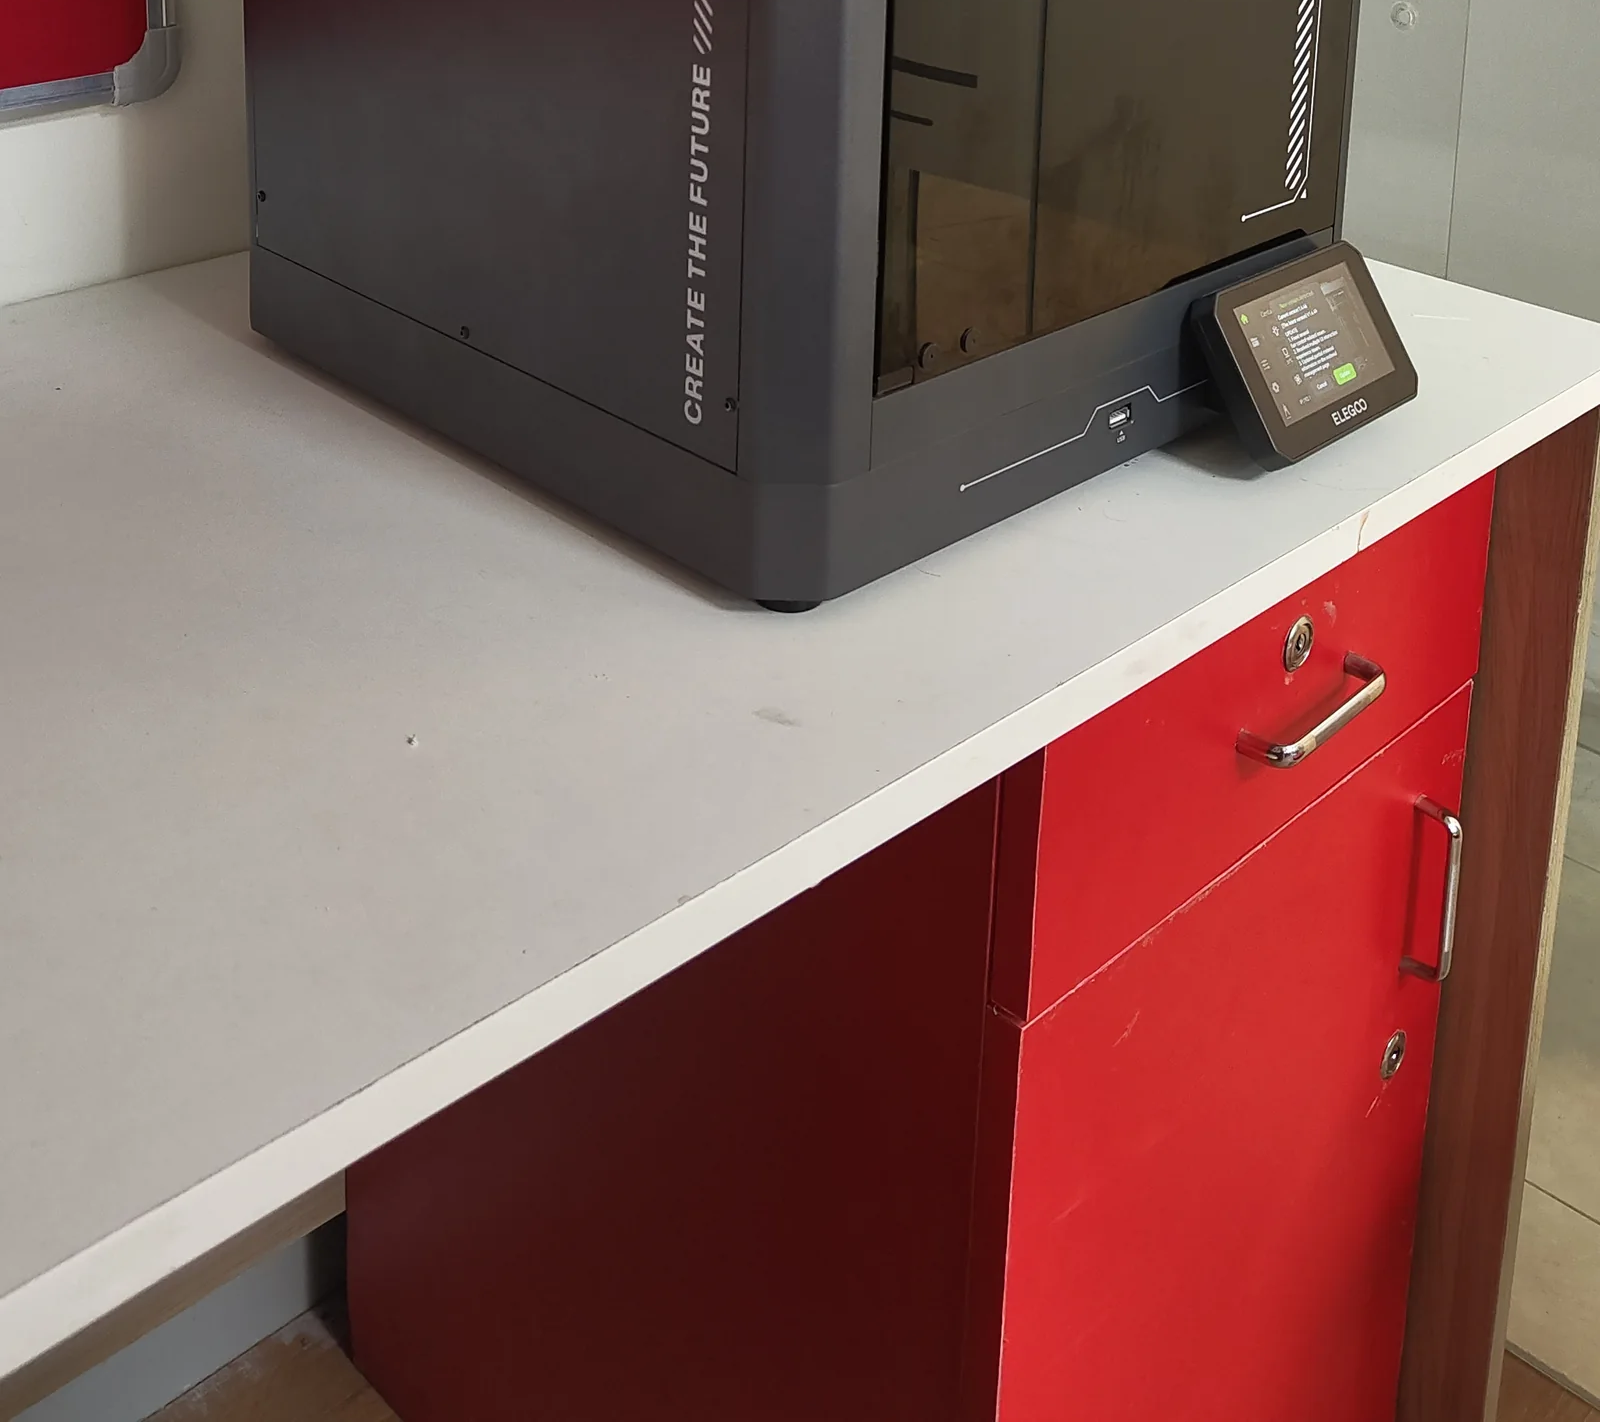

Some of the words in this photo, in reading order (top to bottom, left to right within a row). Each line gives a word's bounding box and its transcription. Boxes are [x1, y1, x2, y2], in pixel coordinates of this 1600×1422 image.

[689, 63, 711, 207] FUTURE
[687, 211, 708, 279] THE
[684, 287, 705, 425] CREATE
[1331, 398, 1368, 426] ELEGOO
